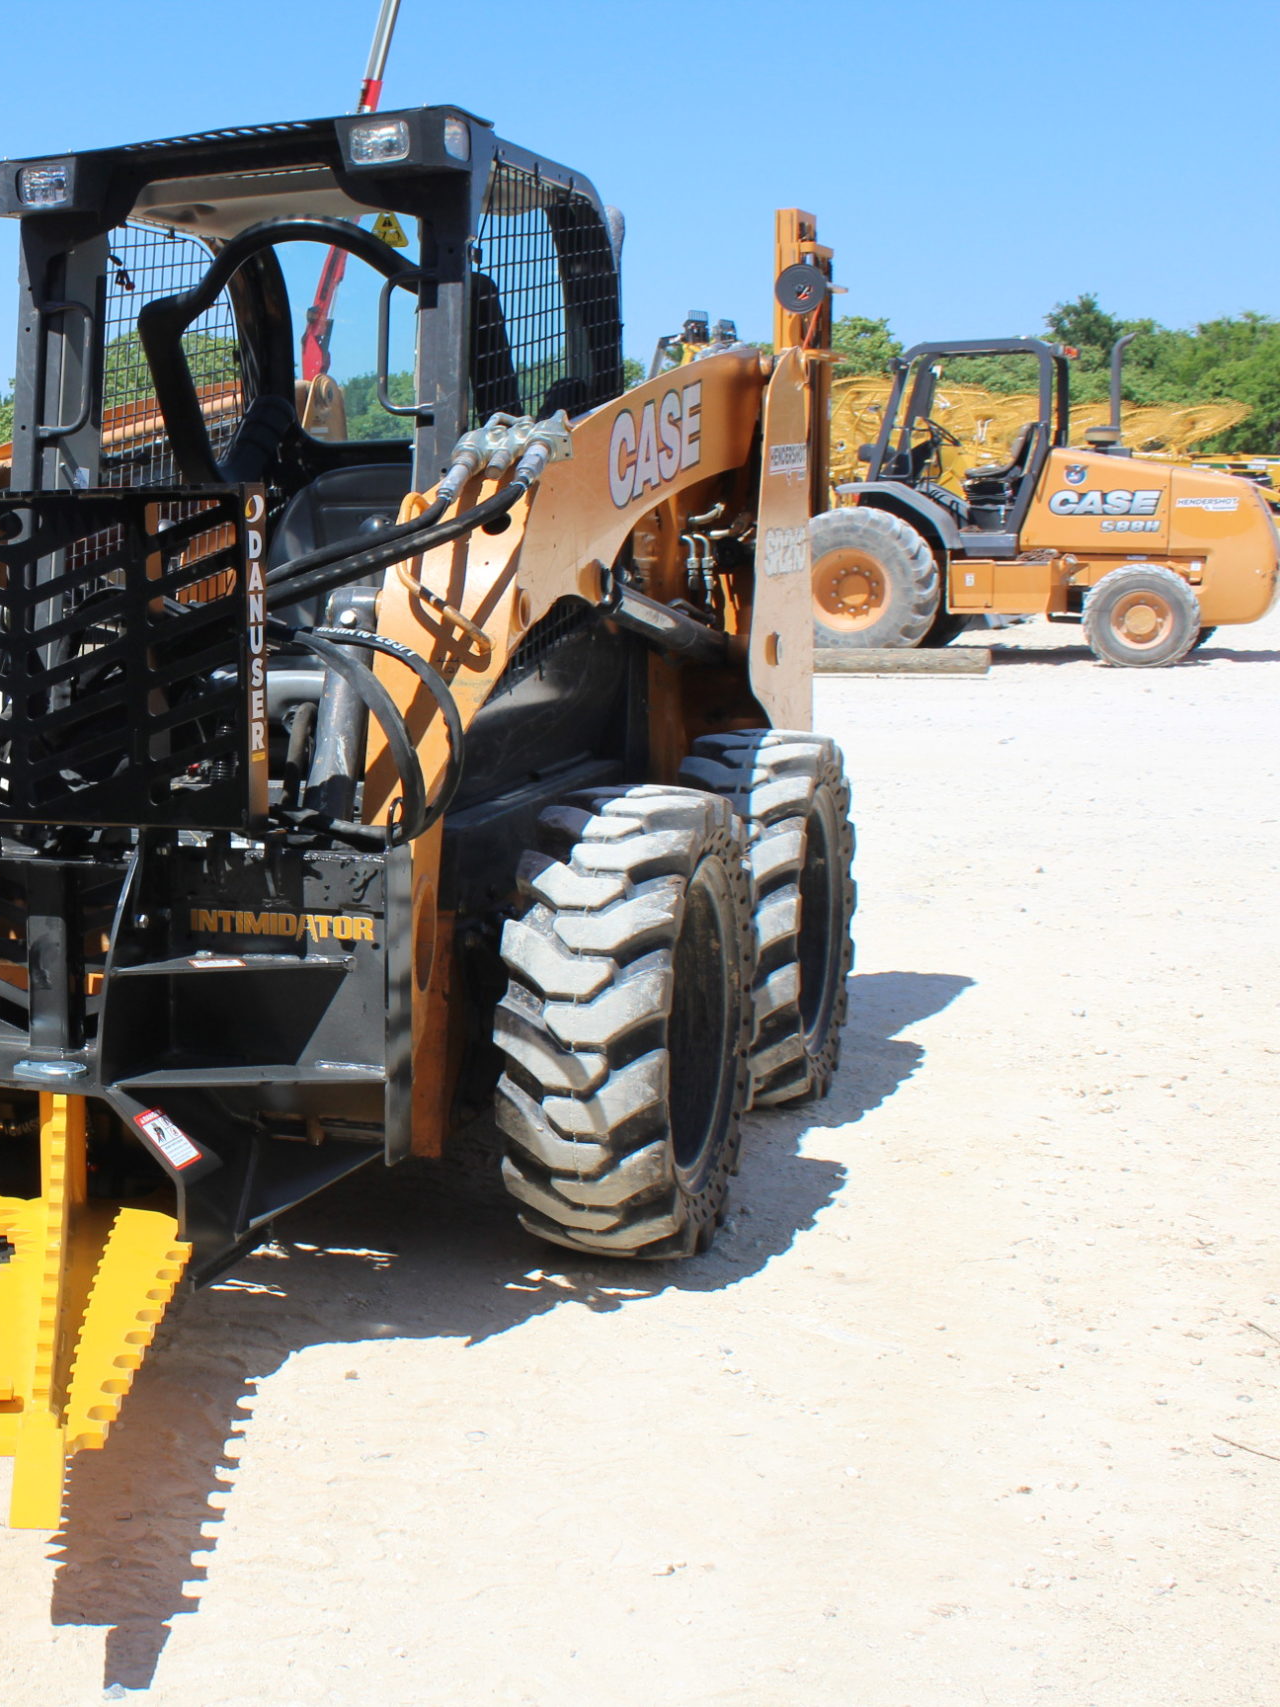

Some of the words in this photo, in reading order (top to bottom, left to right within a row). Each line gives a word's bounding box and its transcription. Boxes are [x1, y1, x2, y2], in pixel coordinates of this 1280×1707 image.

[607, 378, 703, 511] CASE
[1049, 489, 1163, 516] CASE
[248, 530, 265, 751] DANUSER
[190, 909, 375, 943] INTIMIDATOR
